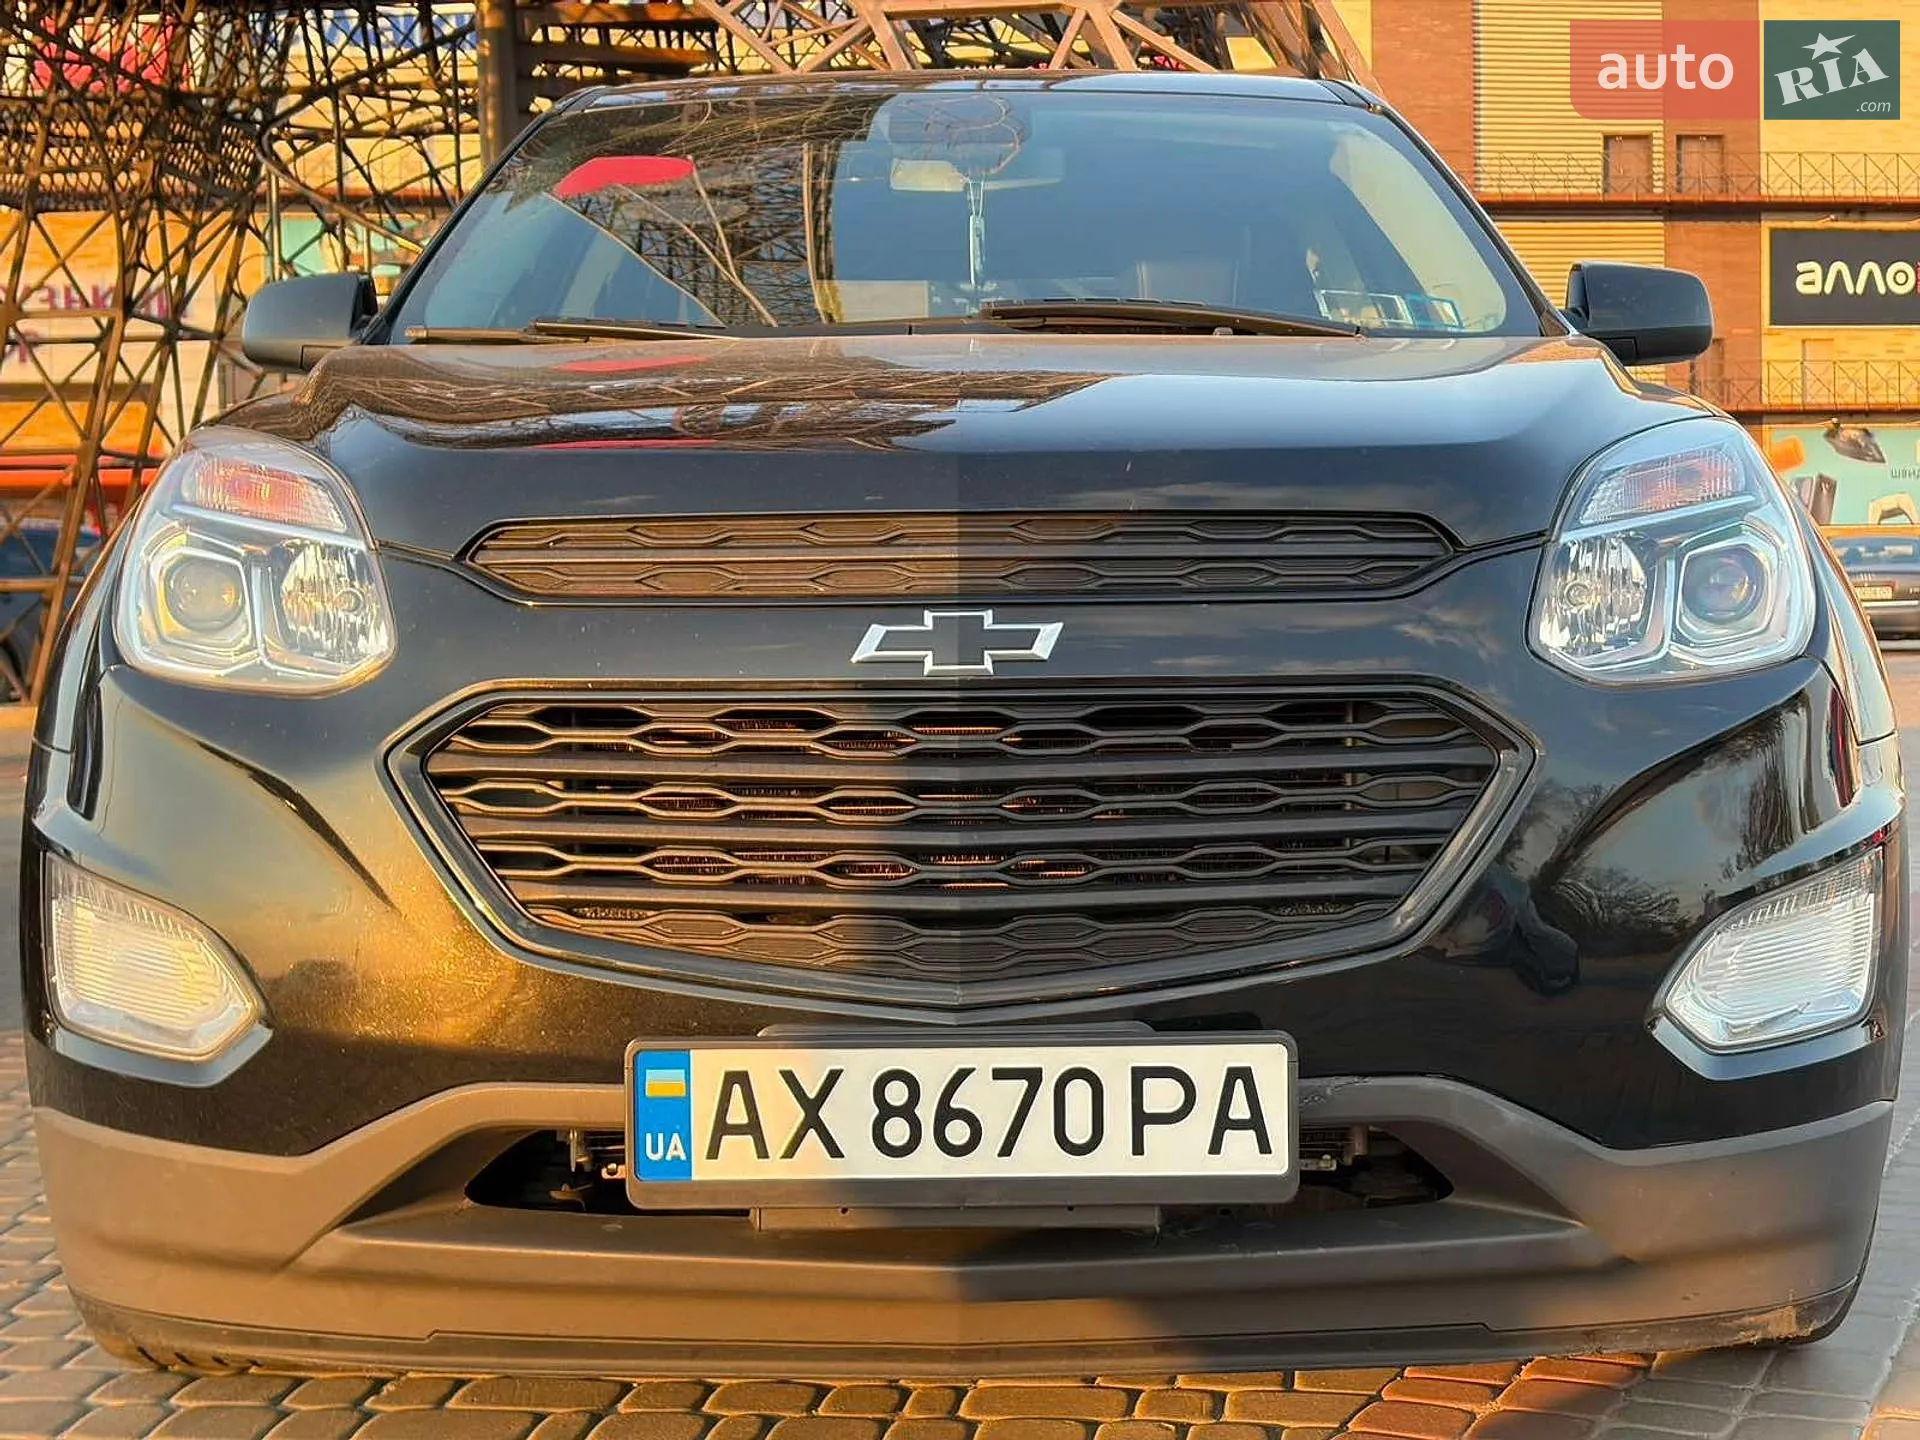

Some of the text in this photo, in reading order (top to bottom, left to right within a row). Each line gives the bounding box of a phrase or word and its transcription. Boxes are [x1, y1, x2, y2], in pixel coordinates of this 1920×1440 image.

[705, 1066, 1273, 1161] AX 8670 PA
[645, 1132, 687, 1161] UA
